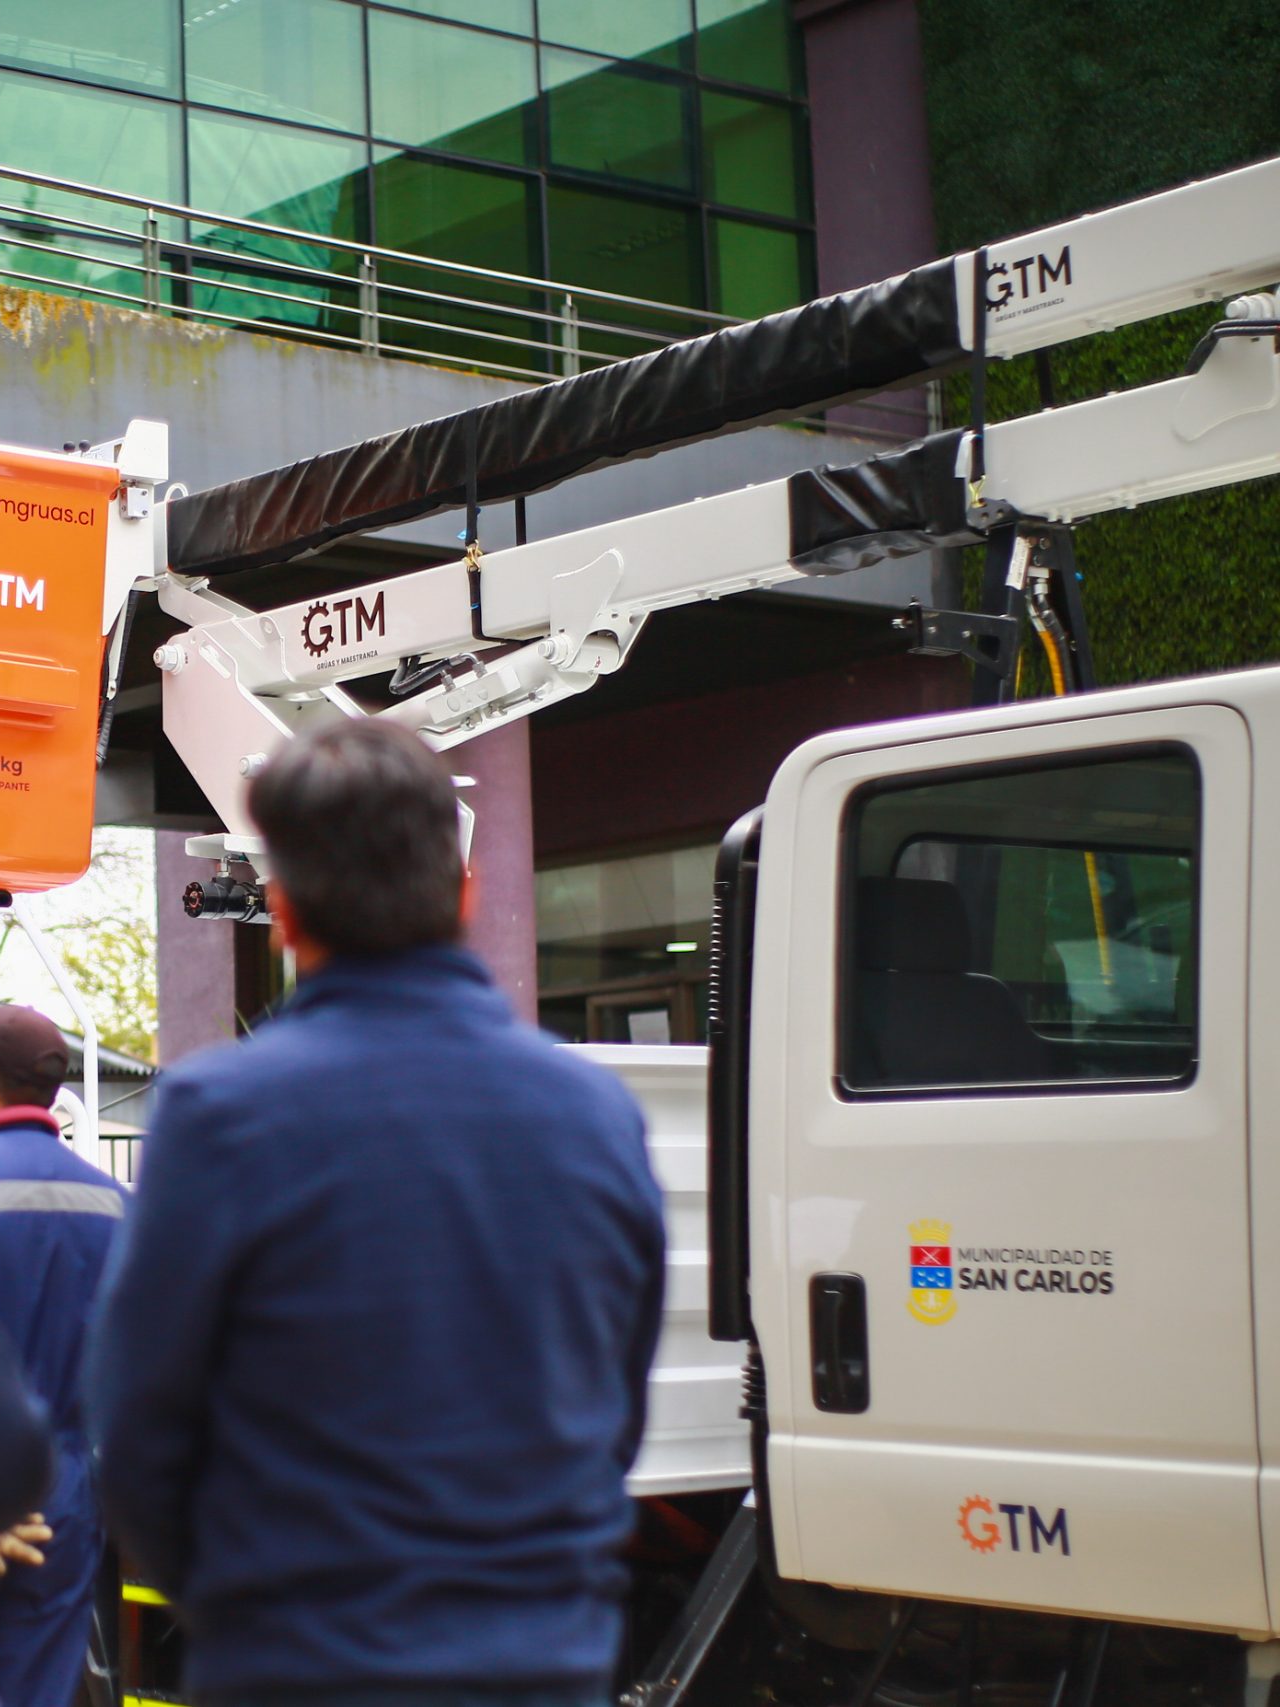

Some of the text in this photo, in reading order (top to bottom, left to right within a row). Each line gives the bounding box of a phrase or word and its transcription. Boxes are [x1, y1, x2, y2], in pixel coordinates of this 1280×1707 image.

[985, 245, 1072, 312] GTM
[301, 591, 385, 658] GTM
[341, 650, 379, 665] MAESTRANZA
[958, 1248, 1114, 1266] MUNICIPALIDAD DE
[959, 1267, 1115, 1295] SAN CARLOS
[957, 1494, 1071, 1556] GTM
